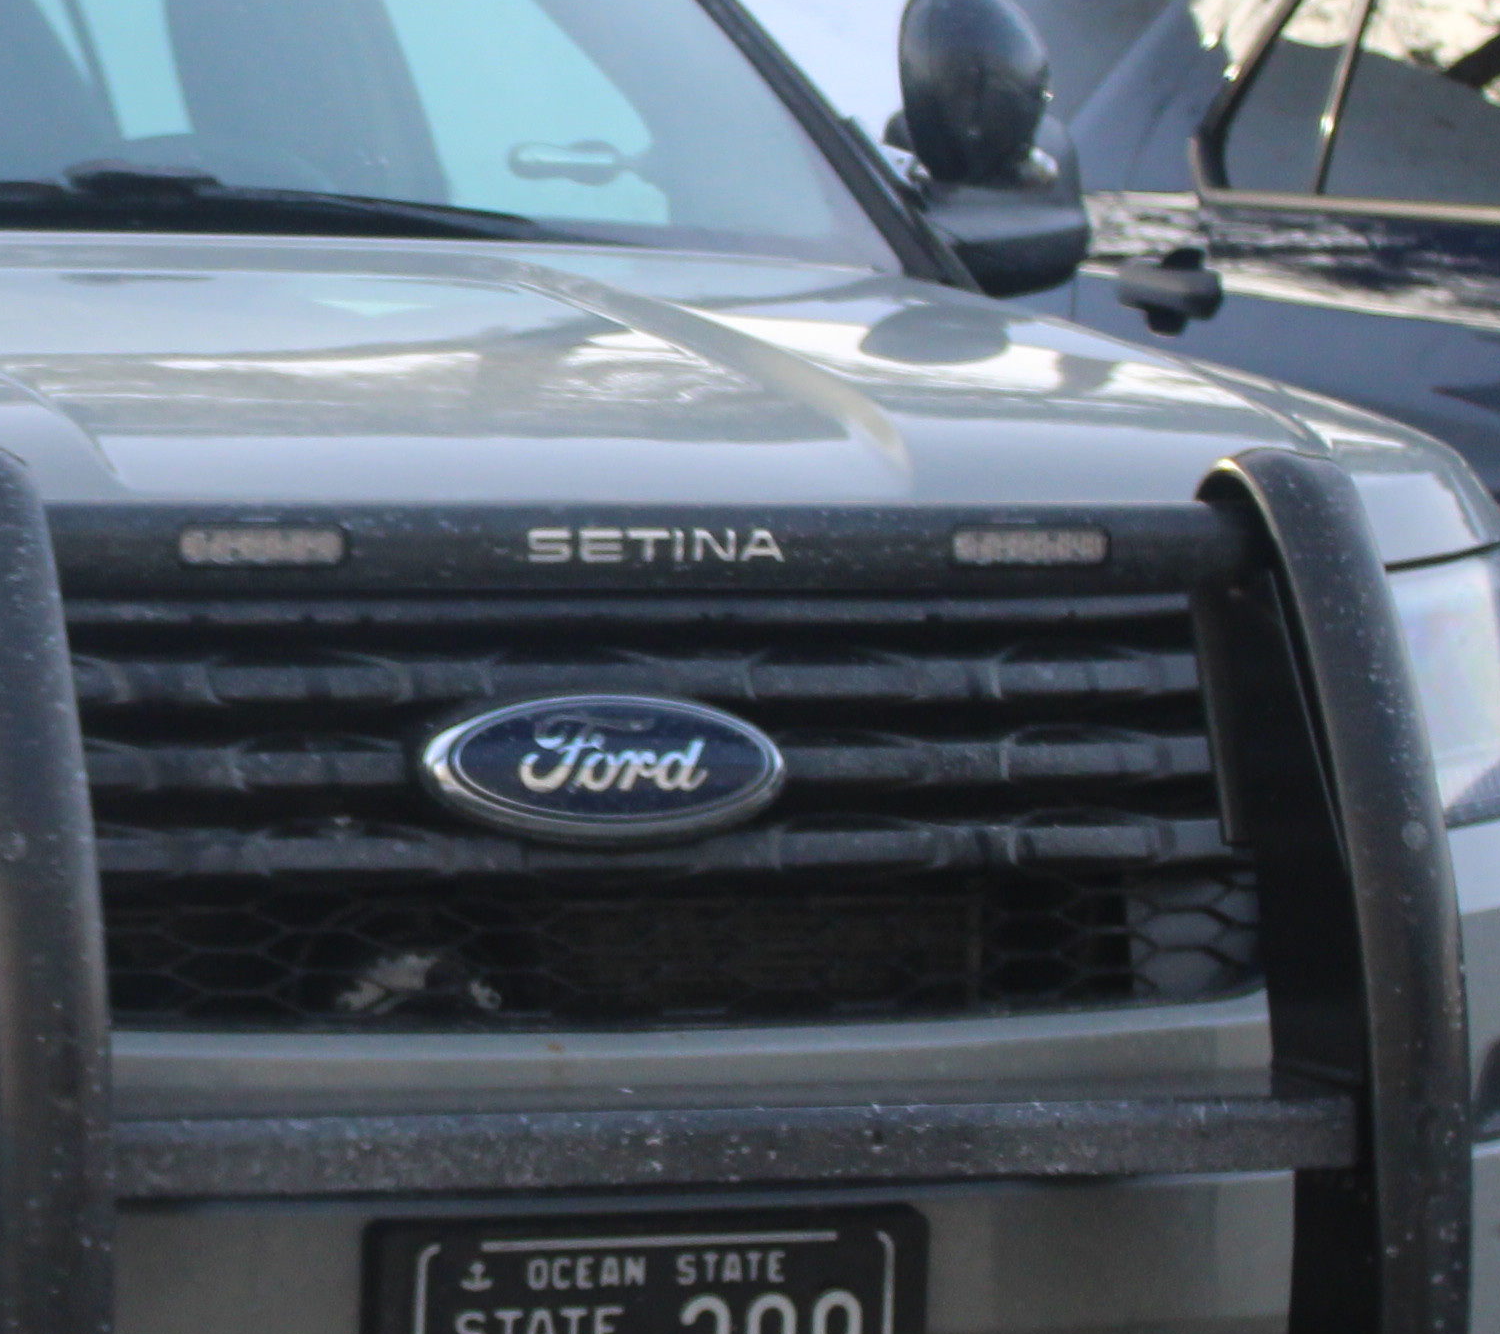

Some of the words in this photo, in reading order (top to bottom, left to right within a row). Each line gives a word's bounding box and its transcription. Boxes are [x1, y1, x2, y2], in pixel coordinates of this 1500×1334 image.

[528, 527, 784, 563] SETINA
[518, 712, 709, 793] Ford
[527, 1257, 646, 1290] OCEAN
[676, 1250, 785, 1286] STATE
